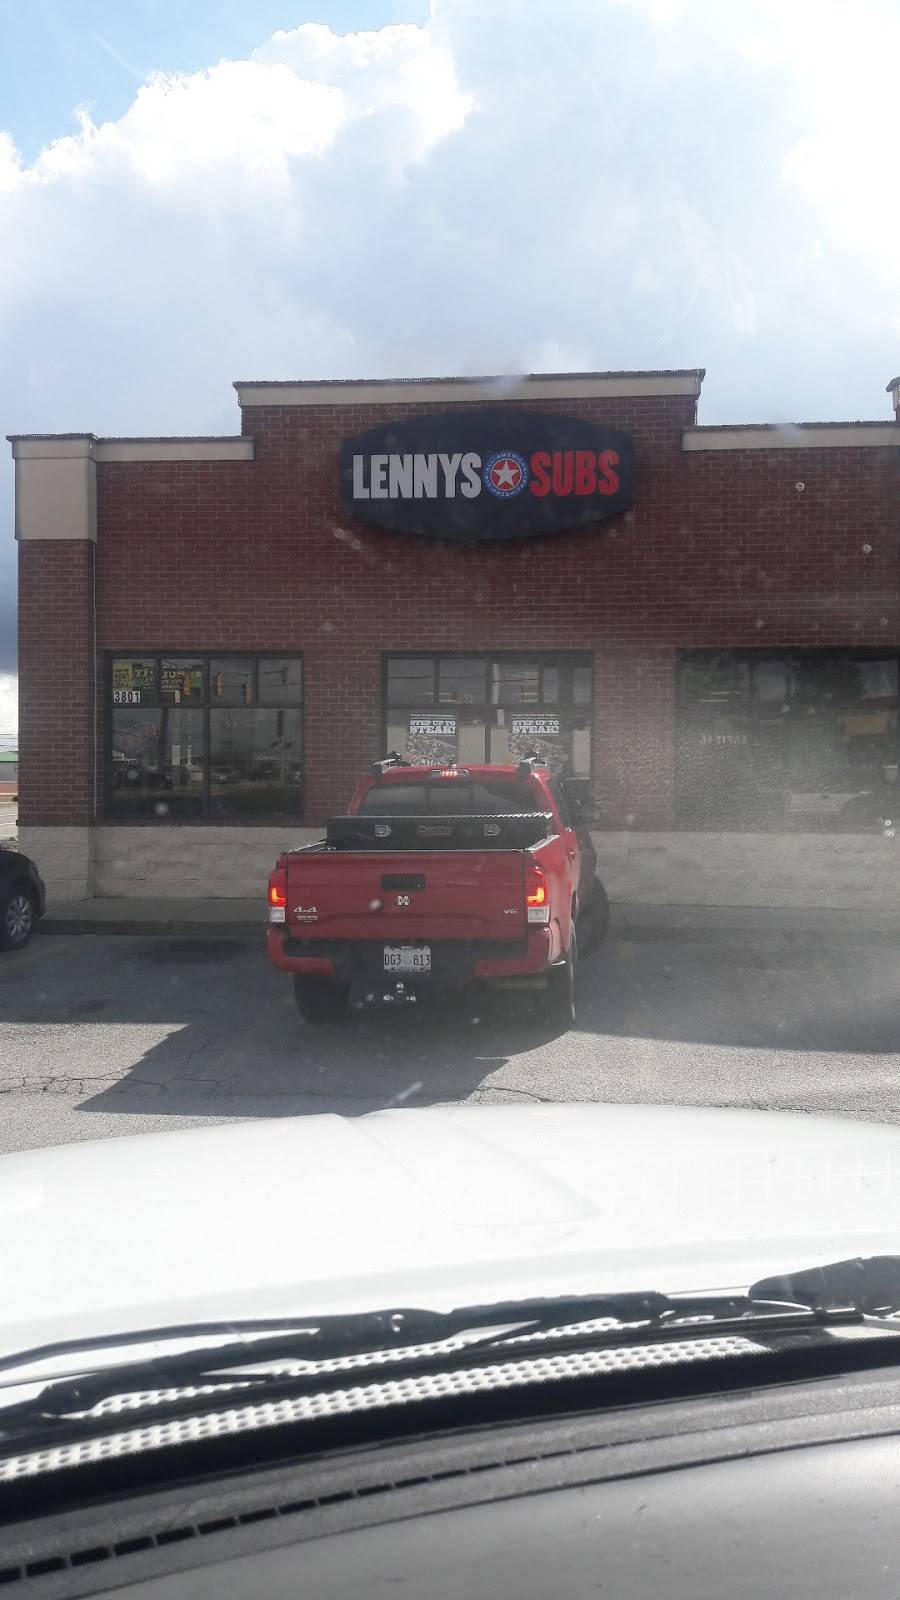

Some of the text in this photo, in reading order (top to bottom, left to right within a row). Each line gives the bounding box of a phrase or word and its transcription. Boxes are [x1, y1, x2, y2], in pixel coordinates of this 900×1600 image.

[352, 450, 620, 499] LENNYS SUBS
[114, 691, 140, 703] 3801
[384, 953, 431, 966] DG3 813
